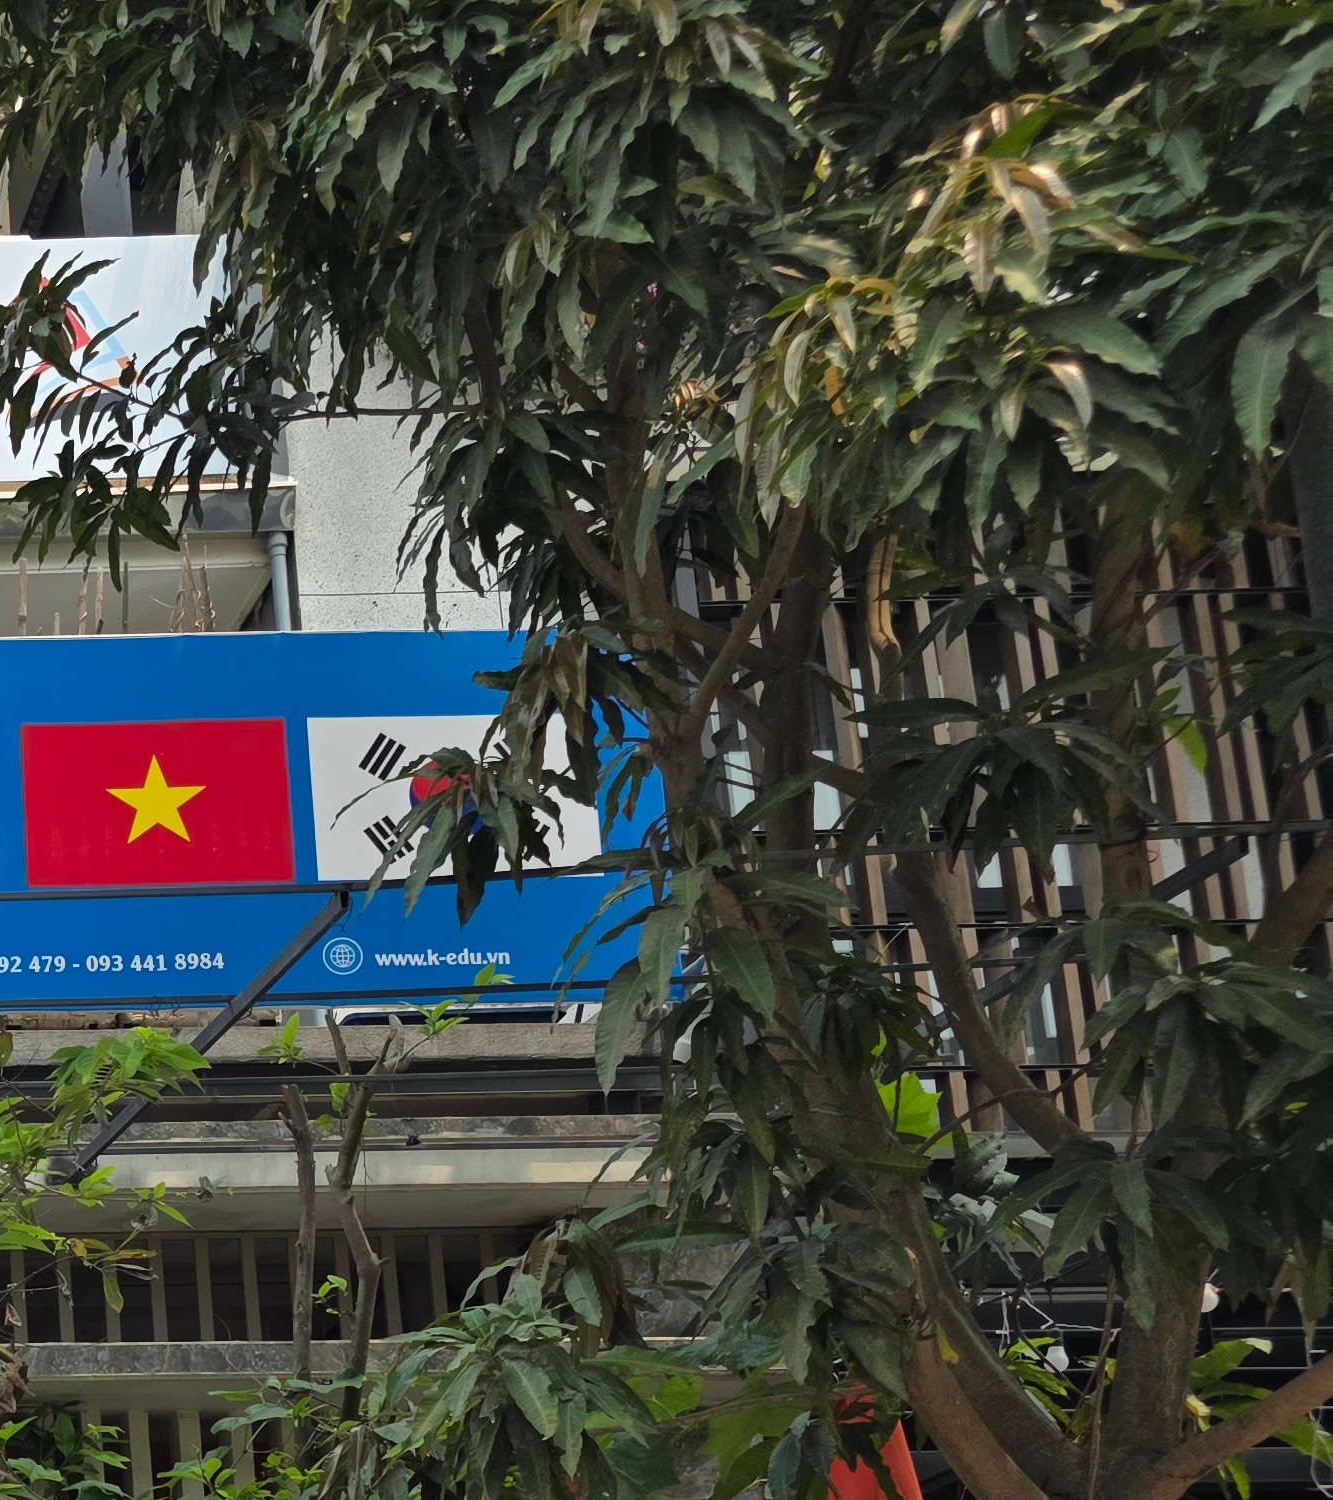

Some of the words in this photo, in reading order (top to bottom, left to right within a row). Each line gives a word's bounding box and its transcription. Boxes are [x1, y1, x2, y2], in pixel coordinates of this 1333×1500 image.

[28, 955, 67, 973] 479
[85, 954, 124, 972] 093
[129, 954, 168, 972] 441
[174, 952, 225, 971] 8984
[374, 948, 511, 967] www.k-edu.vn
